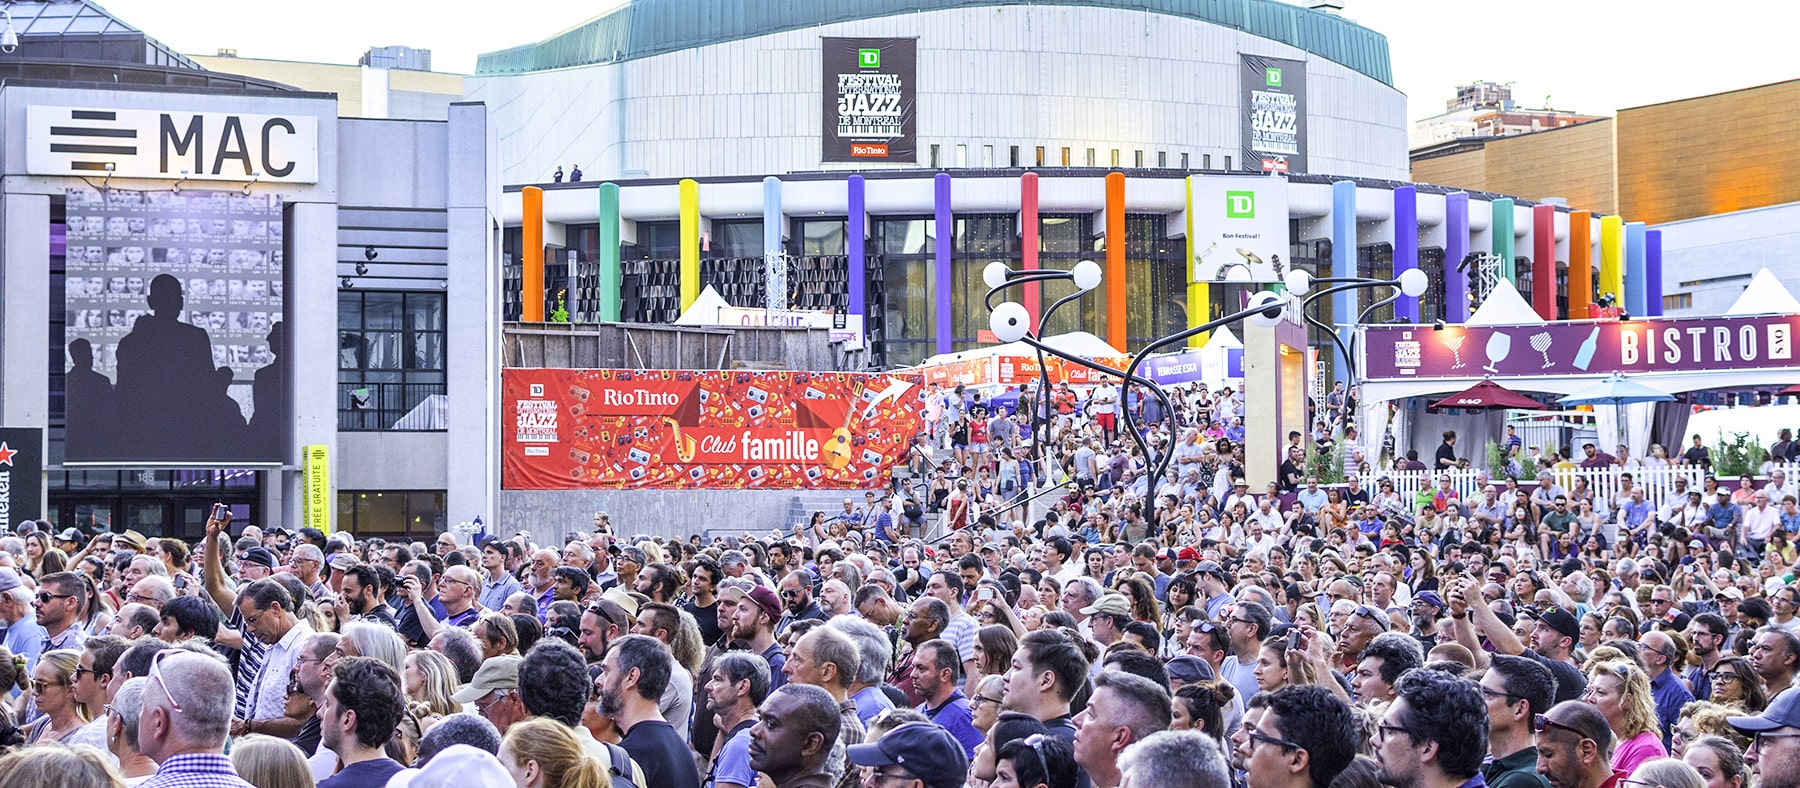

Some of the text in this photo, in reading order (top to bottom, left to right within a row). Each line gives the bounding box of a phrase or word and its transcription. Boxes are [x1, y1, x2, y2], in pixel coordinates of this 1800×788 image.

[861, 52, 878, 64] TD
[838, 74, 901, 86] FESTIVAL
[1269, 71, 1280, 83] TD
[838, 85, 901, 94] INTERNATIONAL
[1251, 90, 1297, 106] FESTIVAL
[838, 94, 901, 116] JAZZ
[839, 116, 851, 125] DE
[1252, 110, 1297, 134] JAZZ
[160, 114, 295, 177] MAC
[1228, 195, 1253, 213] TD
[1621, 325, 1757, 365] BISTRO
[1070, 369, 1086, 378] Club
[1183, 362, 1197, 374] ESKA
[532, 386, 543, 394] TD
[517, 400, 557, 408] FESTIVAL
[517, 413, 558, 428] JAZZ
[701, 431, 819, 461] Club famille
[137, 472, 155, 482] 185
[0, 470, 10, 534] ineken
[311, 464, 322, 532] TRÉE GRATUITE
